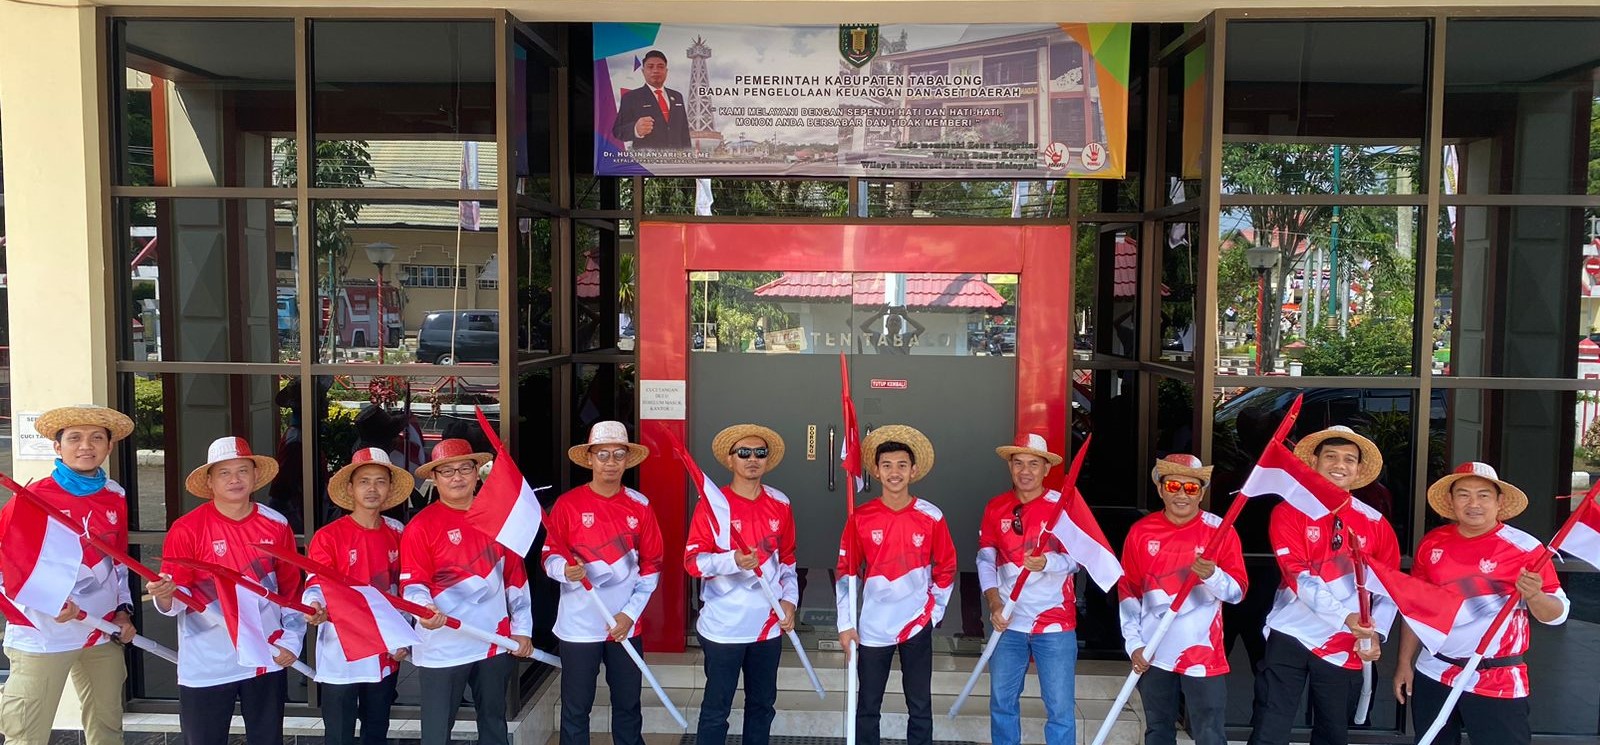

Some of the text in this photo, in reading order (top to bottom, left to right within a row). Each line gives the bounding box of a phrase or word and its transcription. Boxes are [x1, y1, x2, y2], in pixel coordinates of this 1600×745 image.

[735, 75, 982, 86] PEMERINTAH KABUPATEN TABALONG
[698, 87, 739, 97] BADAN
[743, 87, 831, 97] PENGELOLAAN
[836, 87, 902, 97] KEUANGAN
[907, 87, 931, 97] DAN
[935, 87, 966, 97] ASET
[970, 87, 1020, 97] DAERAH
[719, 107, 745, 116] KAMI
[748, 107, 798, 116] MELAYANI
[801, 107, 844, 116] DENGAN
[847, 107, 895, 117] SEPENUH
[899, 107, 921, 117] HATI
[925, 107, 946, 117] DAN
[735, 117, 773, 127] MOHON
[775, 117, 805, 127] ANDA
[806, 117, 863, 127] BERSABAR
[866, 118, 887, 128] DAN
[891, 118, 921, 128] TIDAK
[925, 118, 972, 128] MEMBERI
